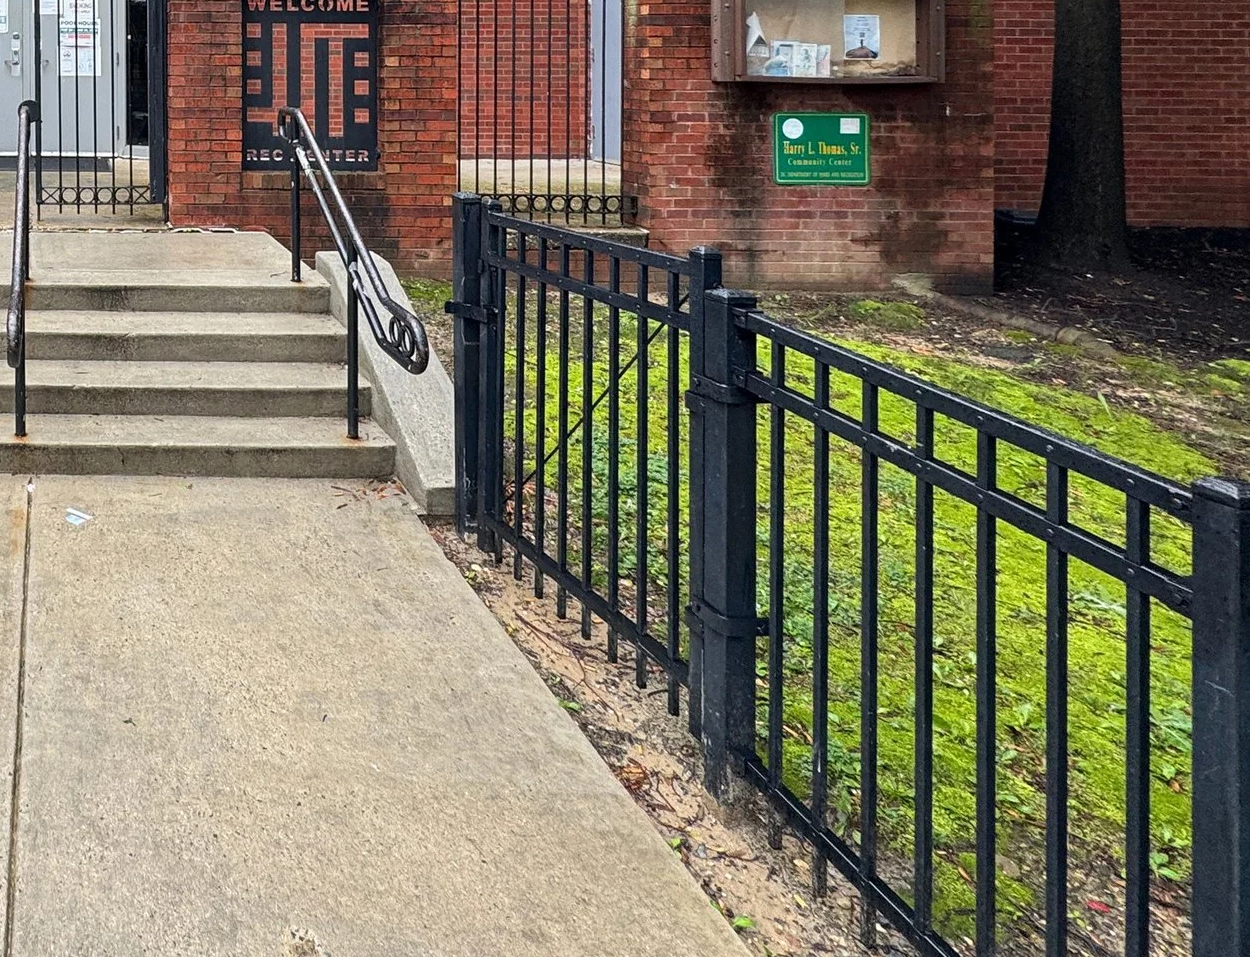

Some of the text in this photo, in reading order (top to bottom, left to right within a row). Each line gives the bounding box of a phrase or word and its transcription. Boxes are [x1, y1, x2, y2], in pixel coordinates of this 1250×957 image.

[783, 140, 862, 157] Harry L. Thomas, Sr.
[247, 149, 369, 161] REC ENTER
[787, 157, 852, 166] Community Center
